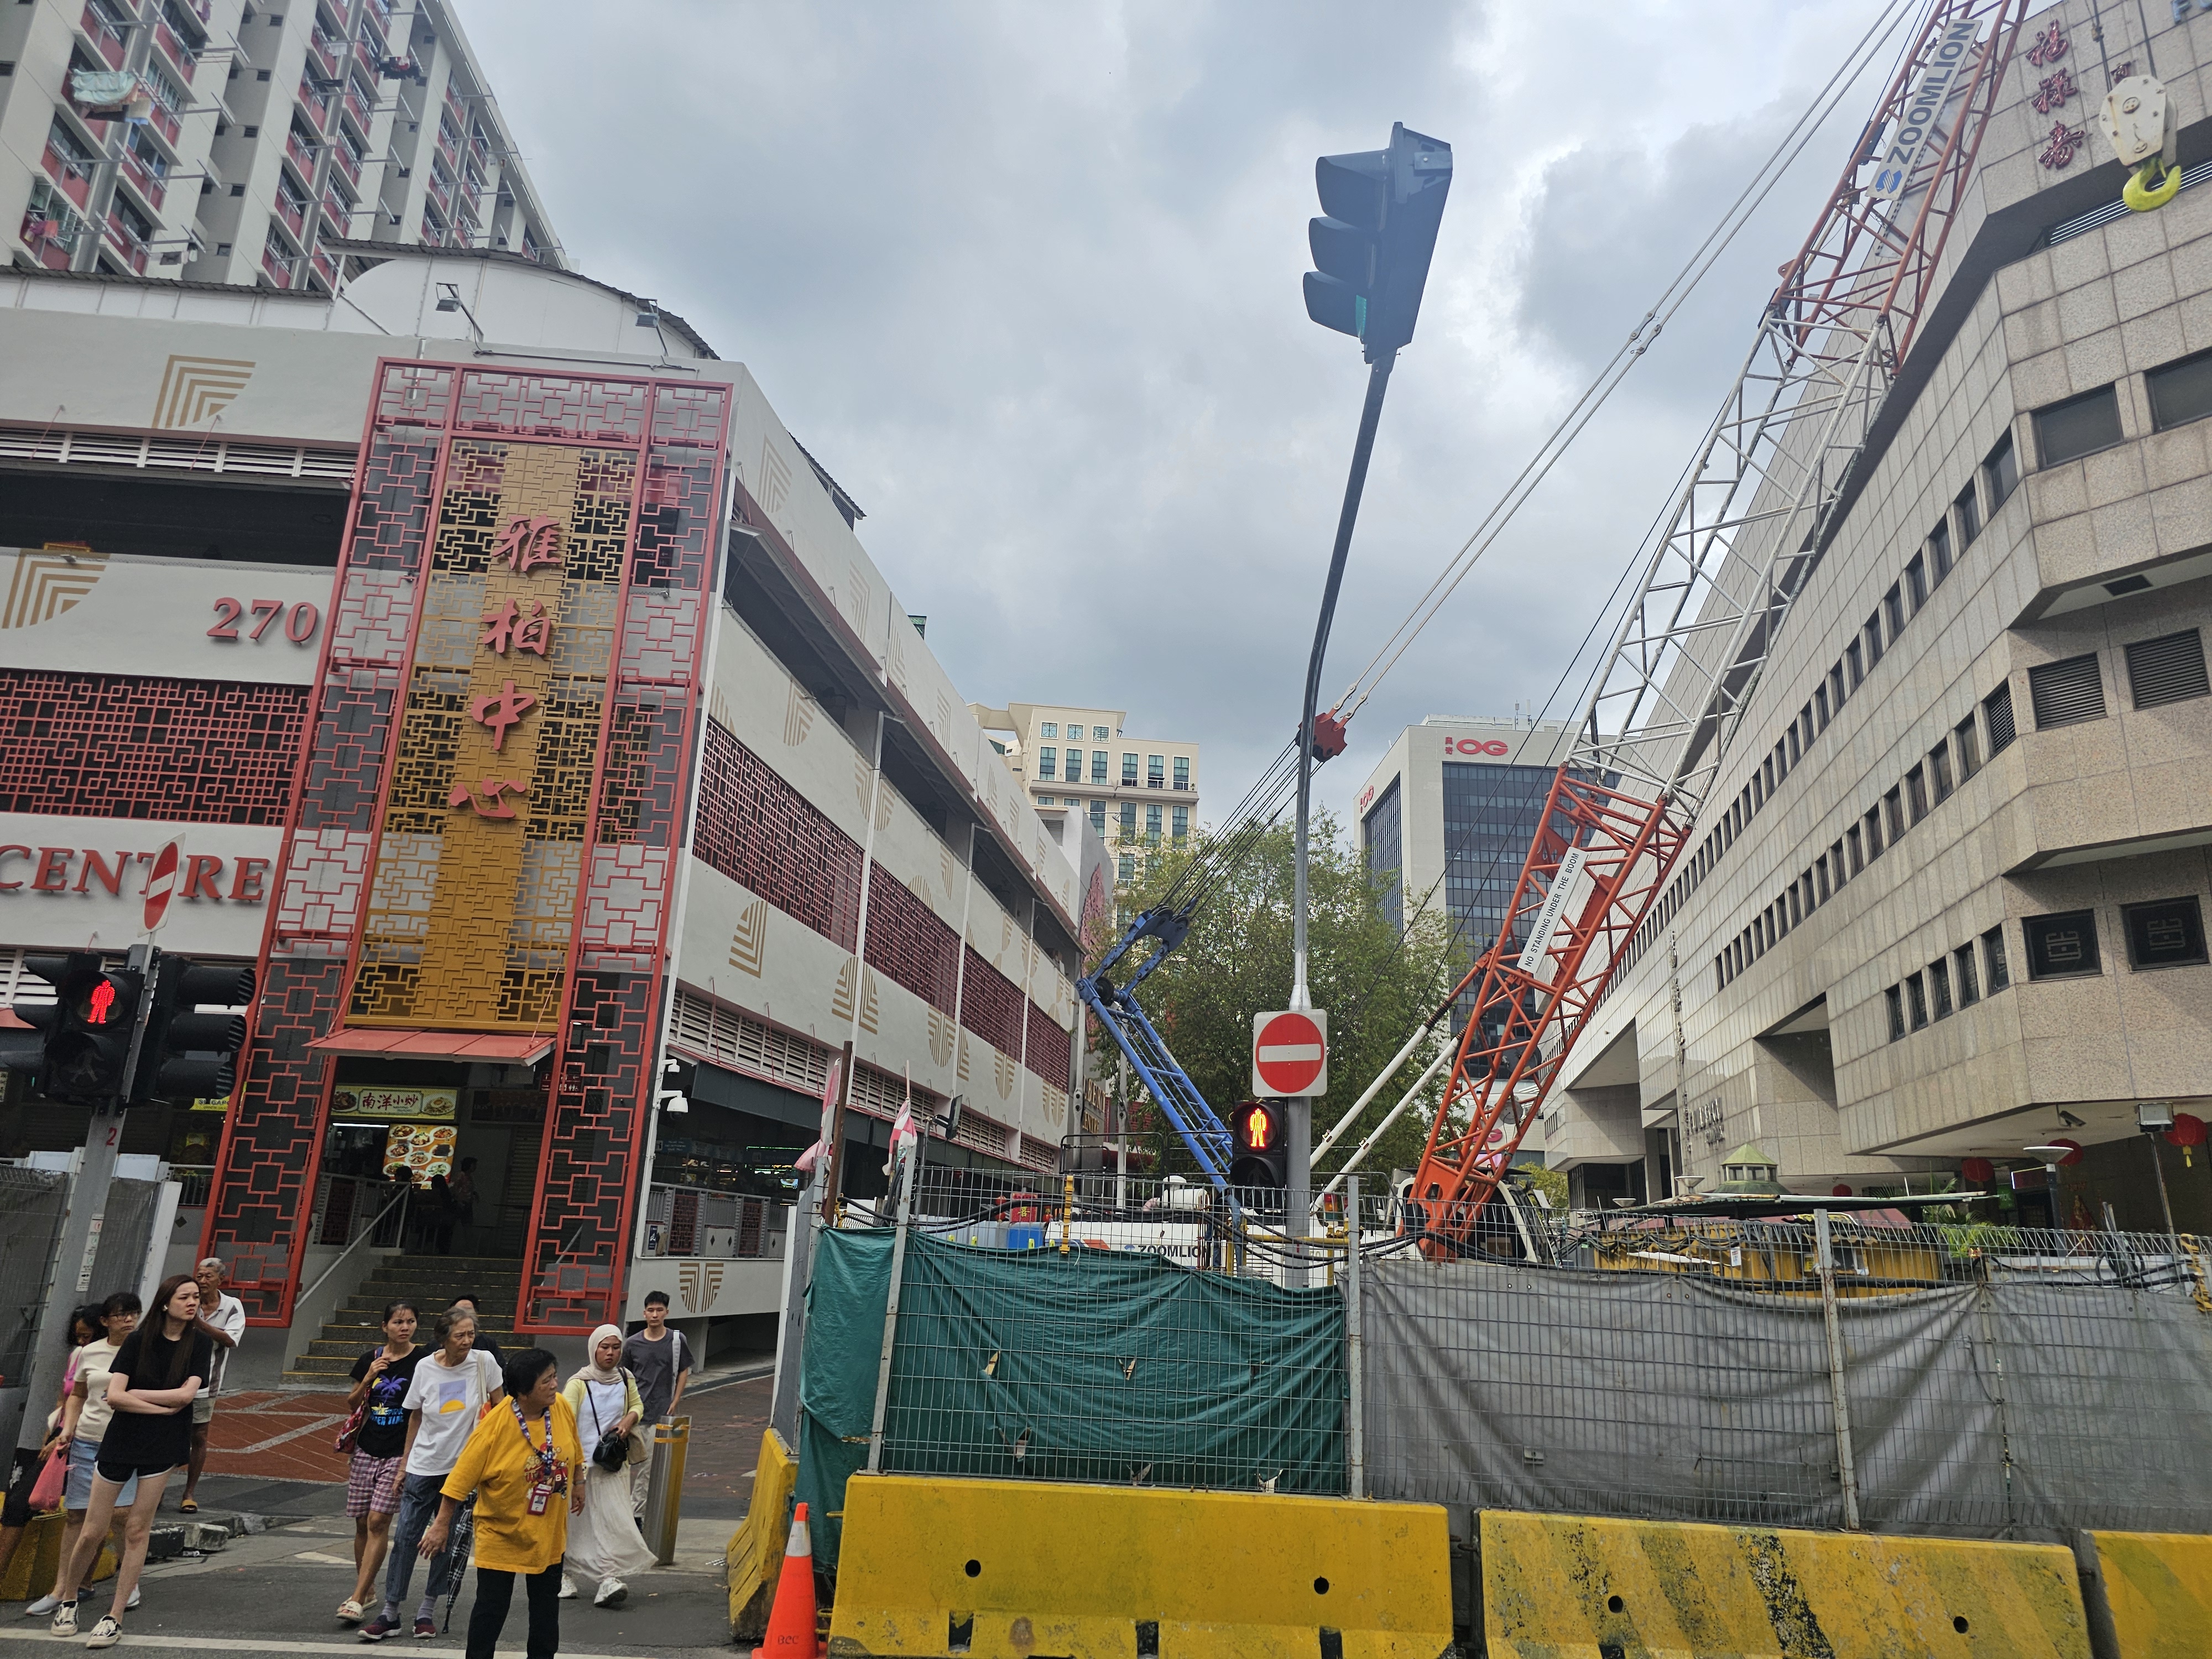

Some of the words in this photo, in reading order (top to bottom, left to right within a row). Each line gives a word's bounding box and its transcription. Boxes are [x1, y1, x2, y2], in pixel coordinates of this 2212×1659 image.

[1887, 22, 1975, 164] ZOOMLION
[206, 597, 320, 643] 270
[1456, 739, 1509, 756] OG
[1524, 956, 1534, 967] NO
[1530, 918, 1551, 953] STANDING
[1546, 893, 1562, 917] UNDER
[1557, 876, 1569, 890] THE
[1565, 853, 1579, 874] BOOM
[106, 1126, 118, 1146] 2
[1138, 1245, 1204, 1258] ZOOMLIO
